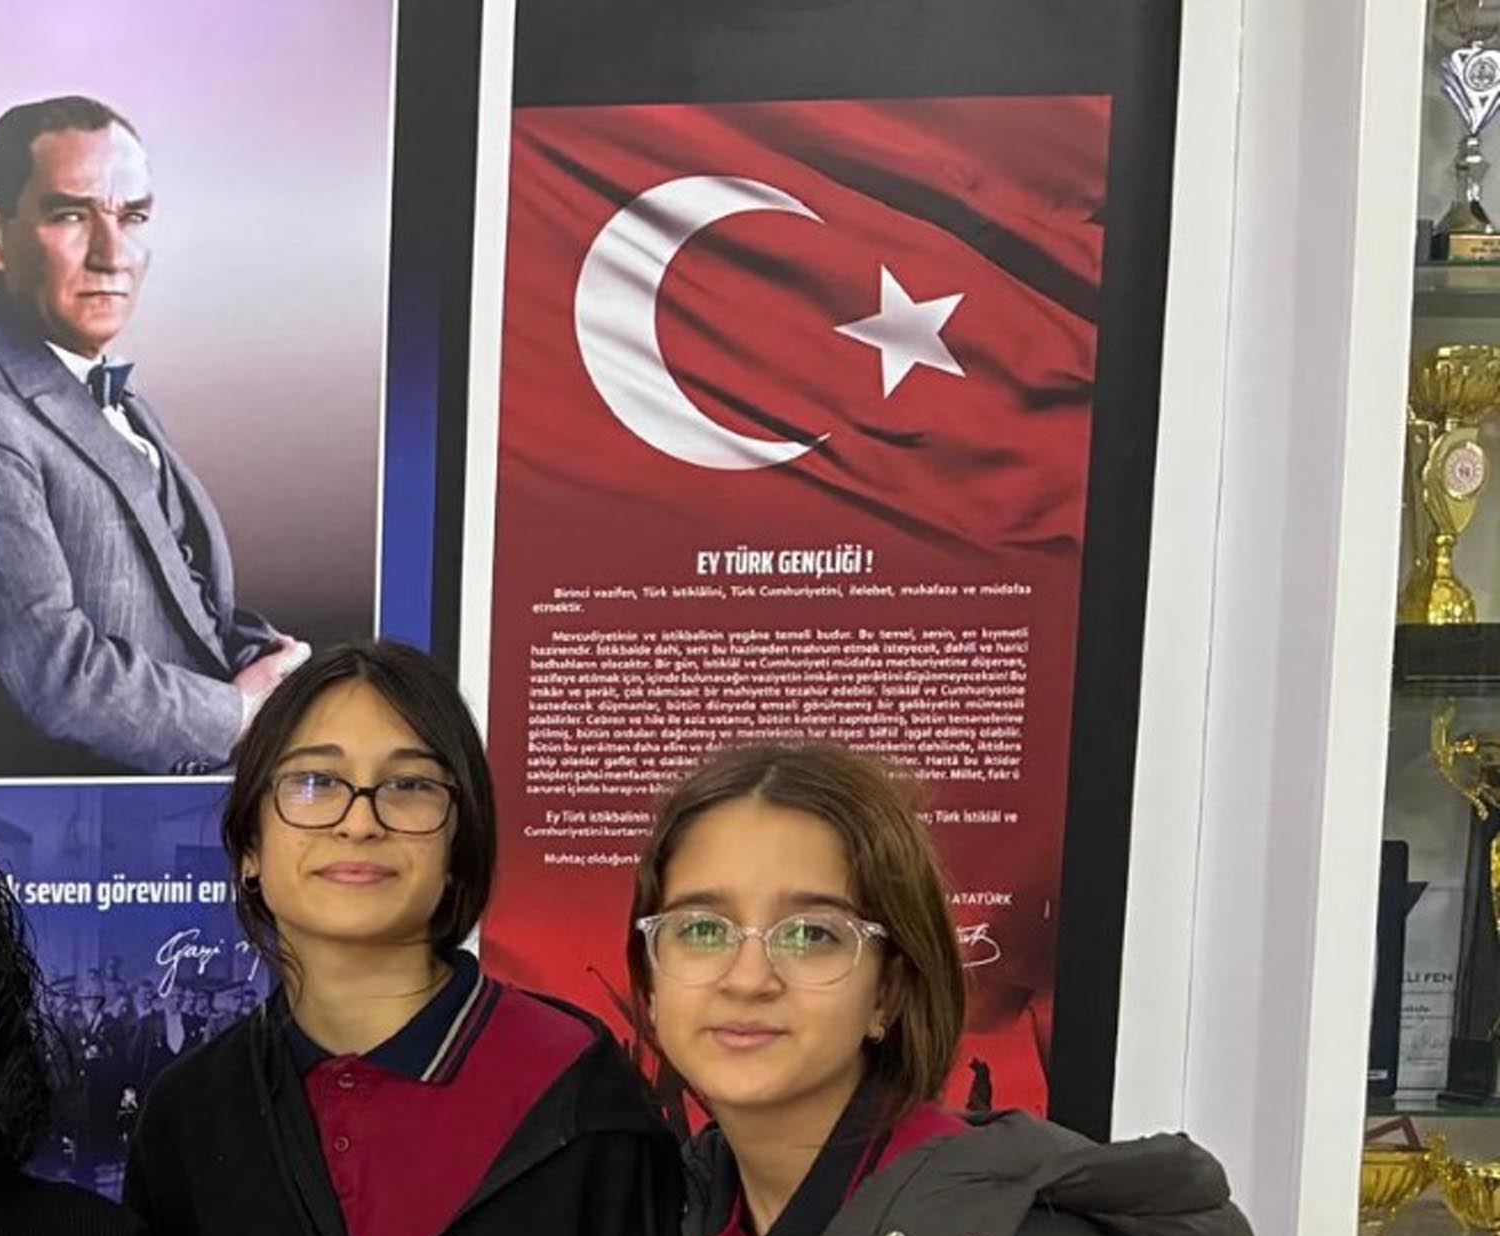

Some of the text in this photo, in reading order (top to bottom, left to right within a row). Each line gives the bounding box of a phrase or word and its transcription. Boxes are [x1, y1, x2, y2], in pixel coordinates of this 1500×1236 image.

[697, 544, 873, 579] EY TÜRK GENÇLİĞİ !
[25, 878, 90, 904] seven
[97, 873, 191, 910] görevini
[198, 878, 226, 903] en
[952, 891, 1013, 905] ATATÜRK
